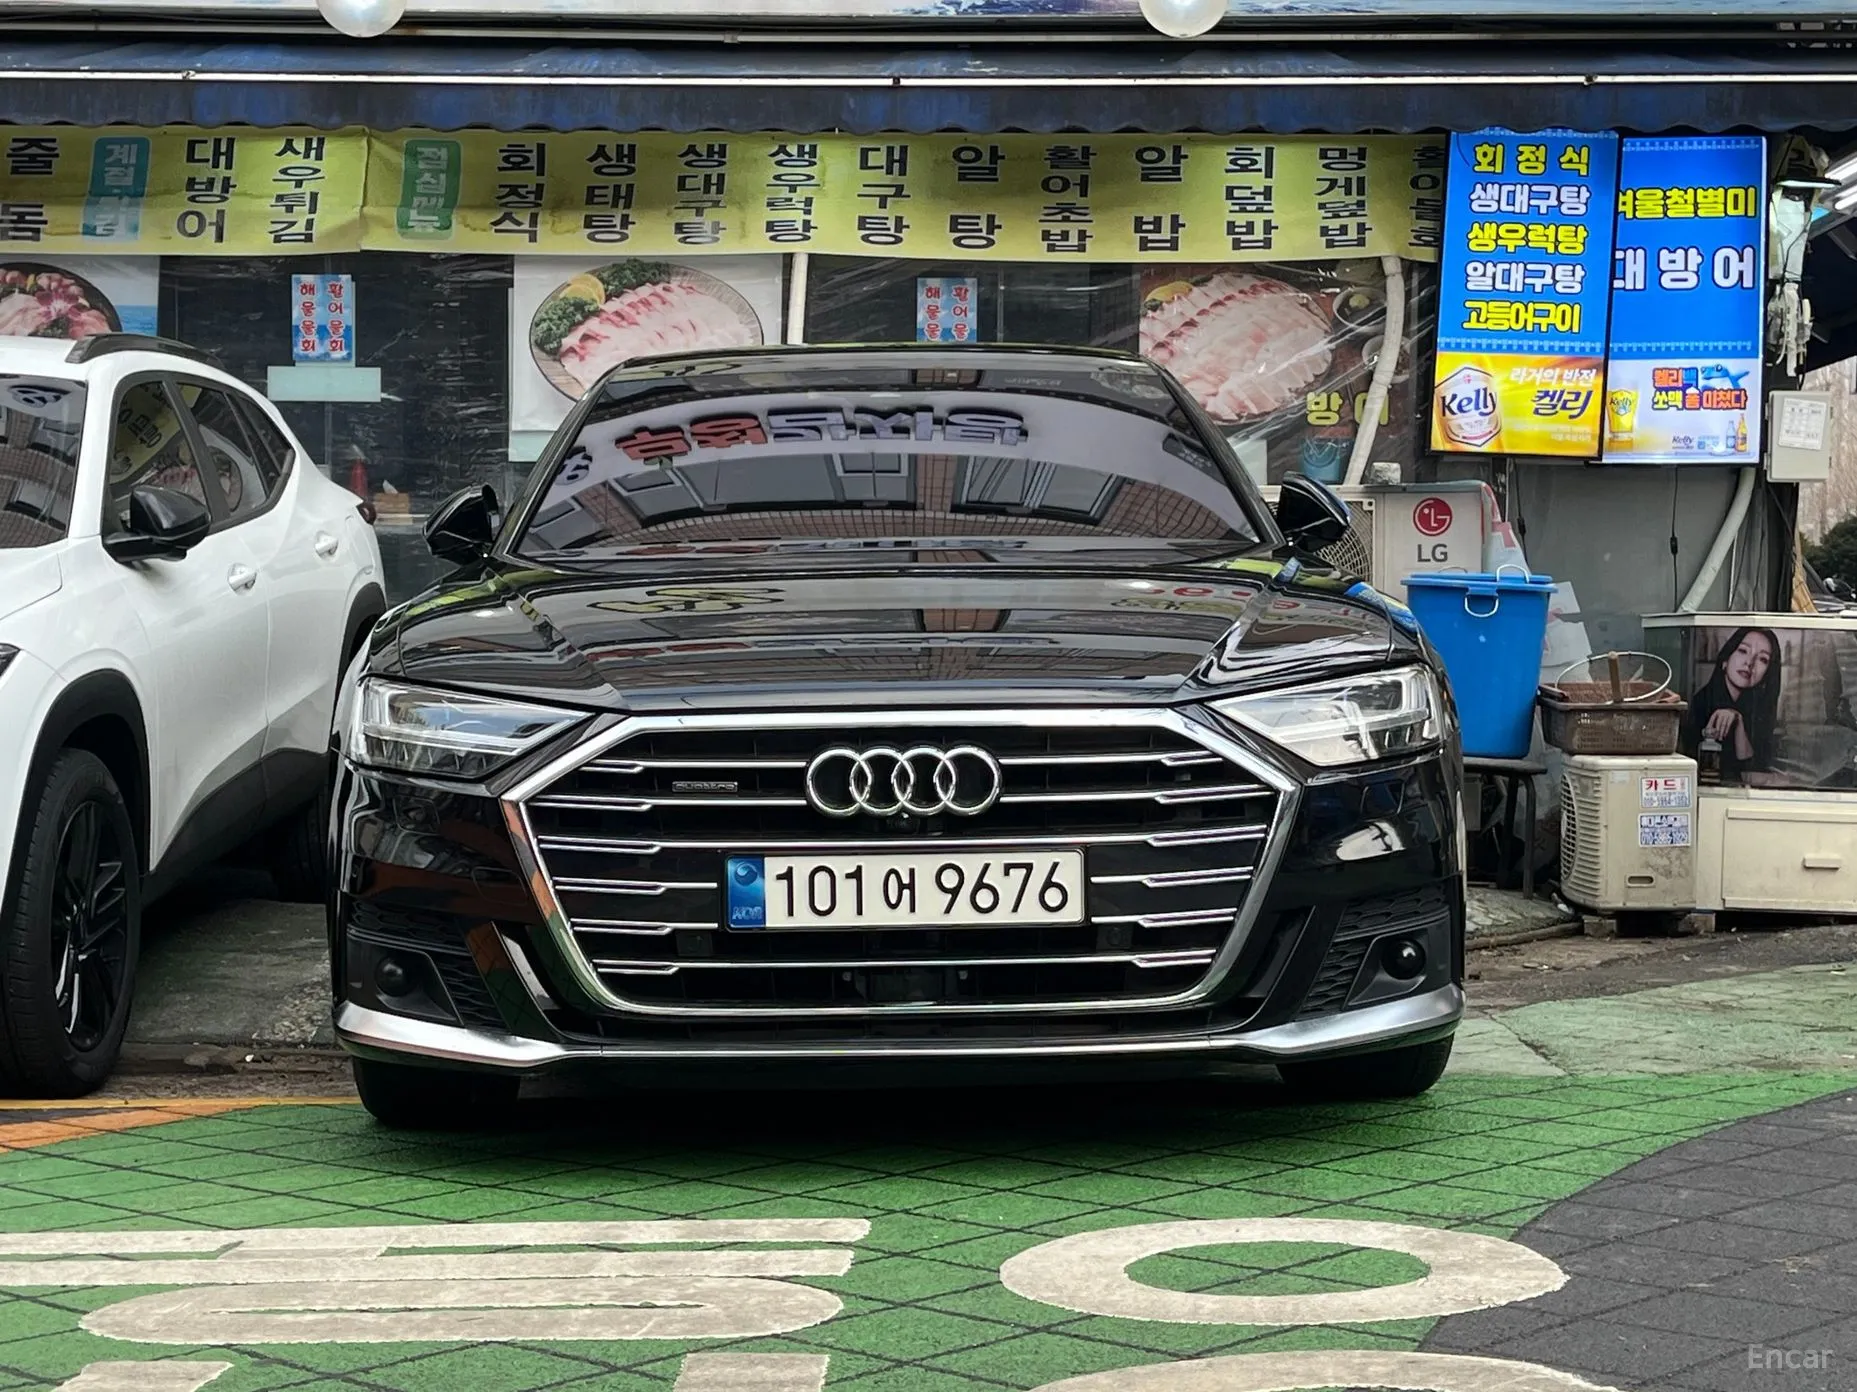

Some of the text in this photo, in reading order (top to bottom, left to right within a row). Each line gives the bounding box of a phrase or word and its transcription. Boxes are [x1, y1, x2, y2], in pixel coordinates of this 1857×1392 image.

[177, 137, 237, 243] 대방어
[269, 136, 326, 243] 새우튀김
[490, 143, 546, 243] 회정식
[583, 143, 637, 244] 생태탕
[674, 143, 728, 245] 생대구탕
[765, 143, 820, 243] 생우럭탕
[857, 144, 911, 246] 대구탕
[948, 144, 1006, 250] 알탕
[1039, 144, 1099, 253] 활어초밥
[1133, 144, 1189, 252] 알밥
[1224, 145, 1280, 250] 회덮밥
[1315, 145, 1374, 249] 멍게덮밥
[1467, 221, 1589, 255] 생우럭탕
[1469, 182, 1592, 216] 생대구탕
[1462, 300, 1581, 333] 고등어구이
[1465, 260, 1586, 294] 알대구탕
[1440, 386, 1497, 418] Kelly
[1510, 367, 1597, 387] 라거의 반전
[1531, 388, 1594, 420] 켈리
[1417, 543, 1449, 563] LG
[934, 861, 1069, 914] 9676
